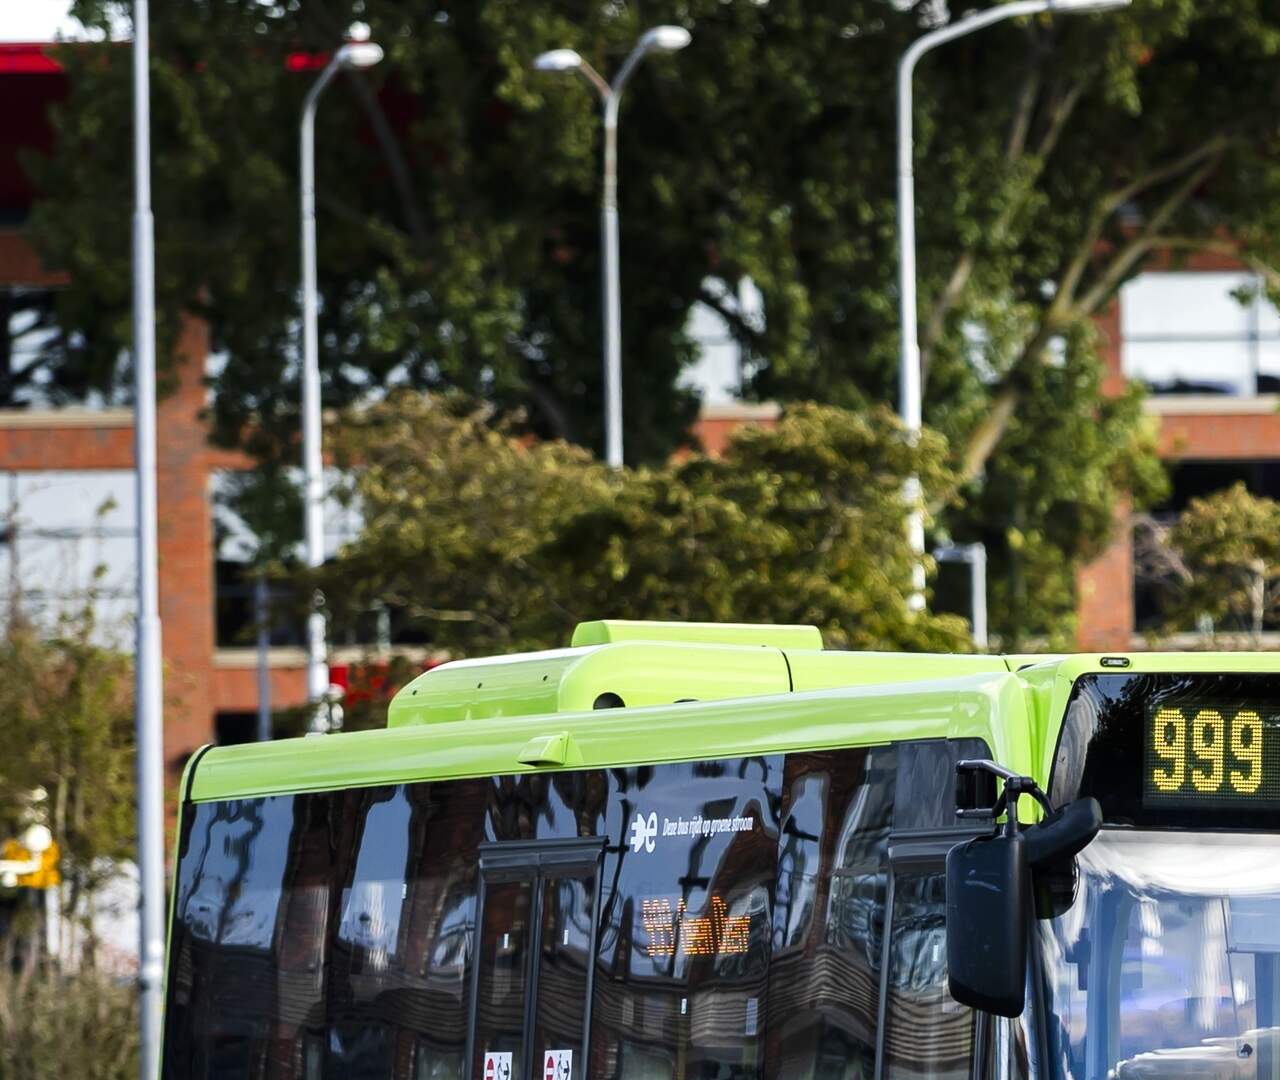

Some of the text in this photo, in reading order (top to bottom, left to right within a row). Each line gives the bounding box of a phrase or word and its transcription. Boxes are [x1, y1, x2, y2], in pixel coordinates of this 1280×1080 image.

[1153, 709, 1263, 793] 999
[662, 815, 754, 838] Deze bus rijdt op groene stroom
